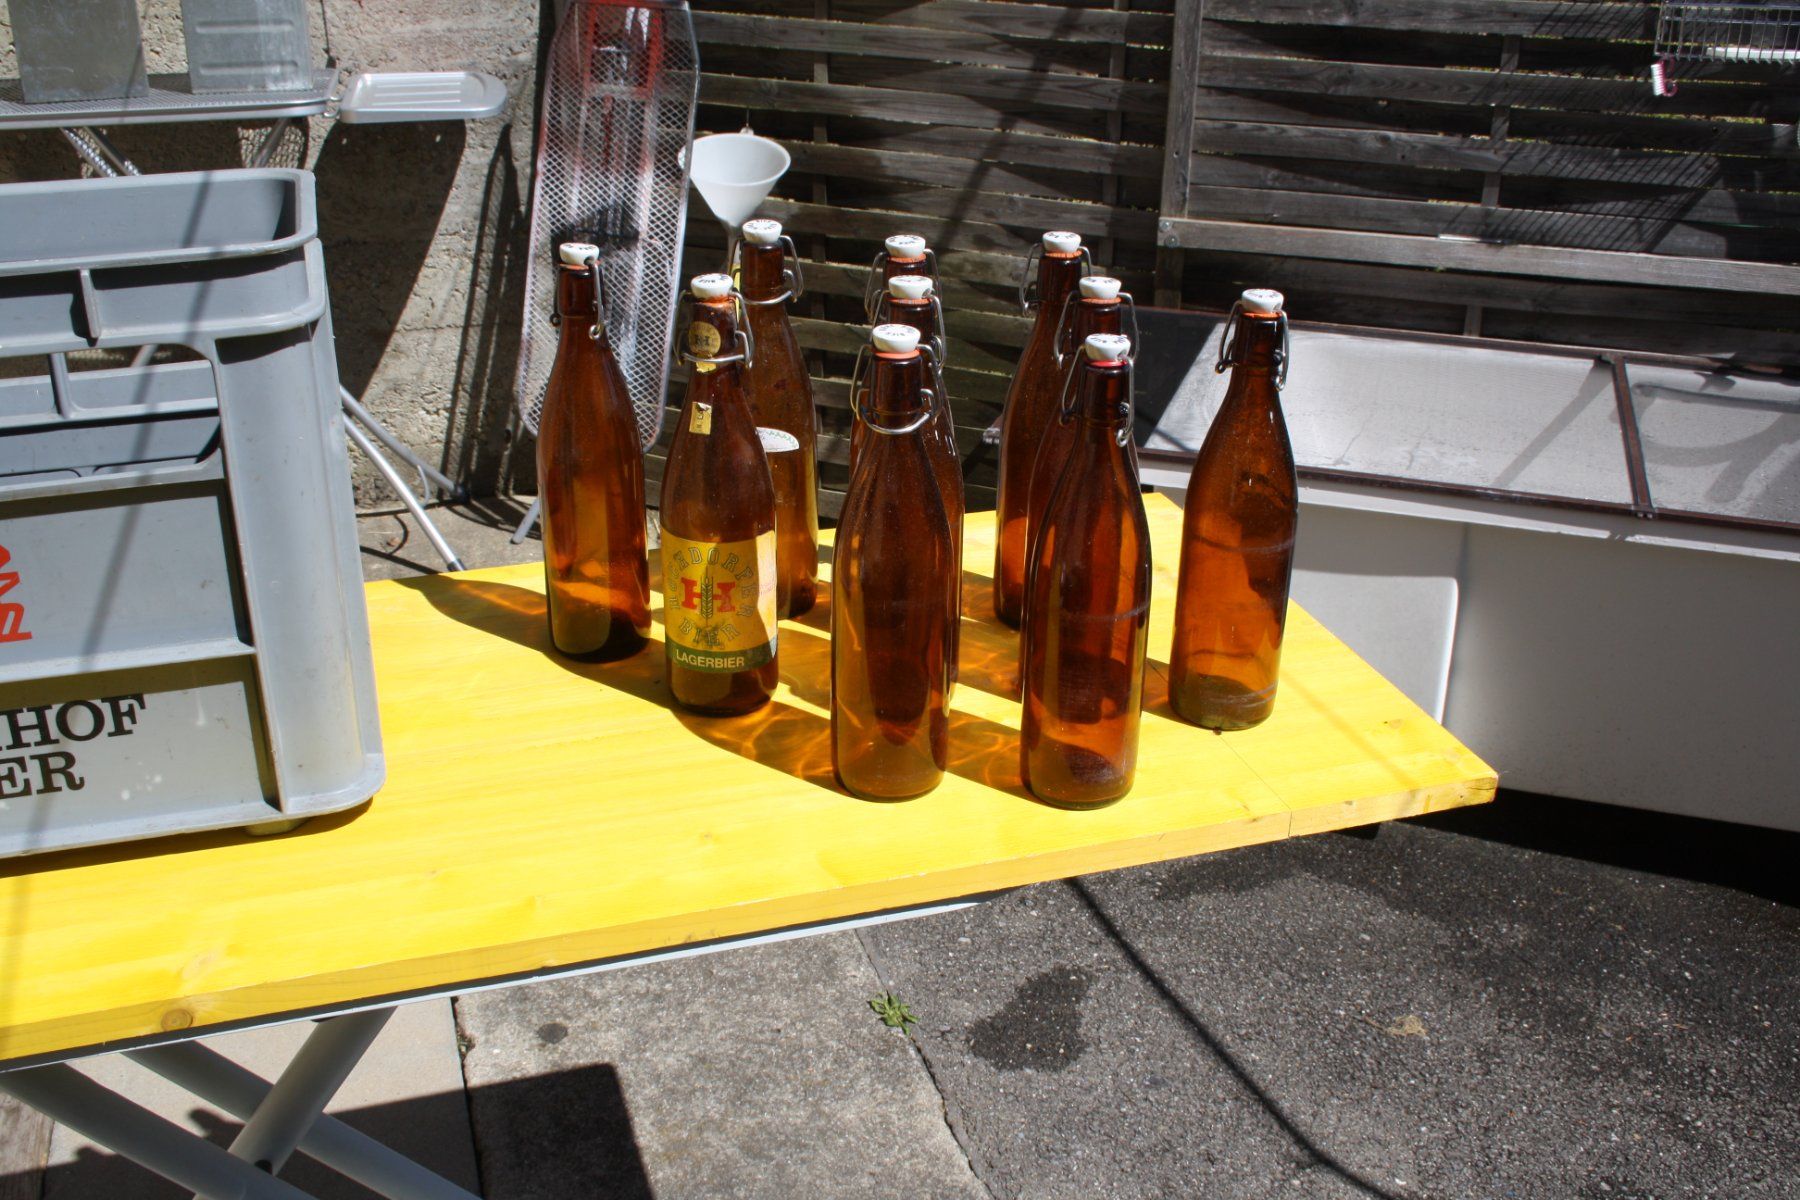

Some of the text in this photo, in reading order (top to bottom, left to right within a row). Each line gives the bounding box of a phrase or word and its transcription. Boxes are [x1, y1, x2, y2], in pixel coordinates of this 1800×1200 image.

[679, 619, 740, 646] BIER
[676, 649, 745, 668] LAGERBIER
[0, 693, 146, 750] HOF
